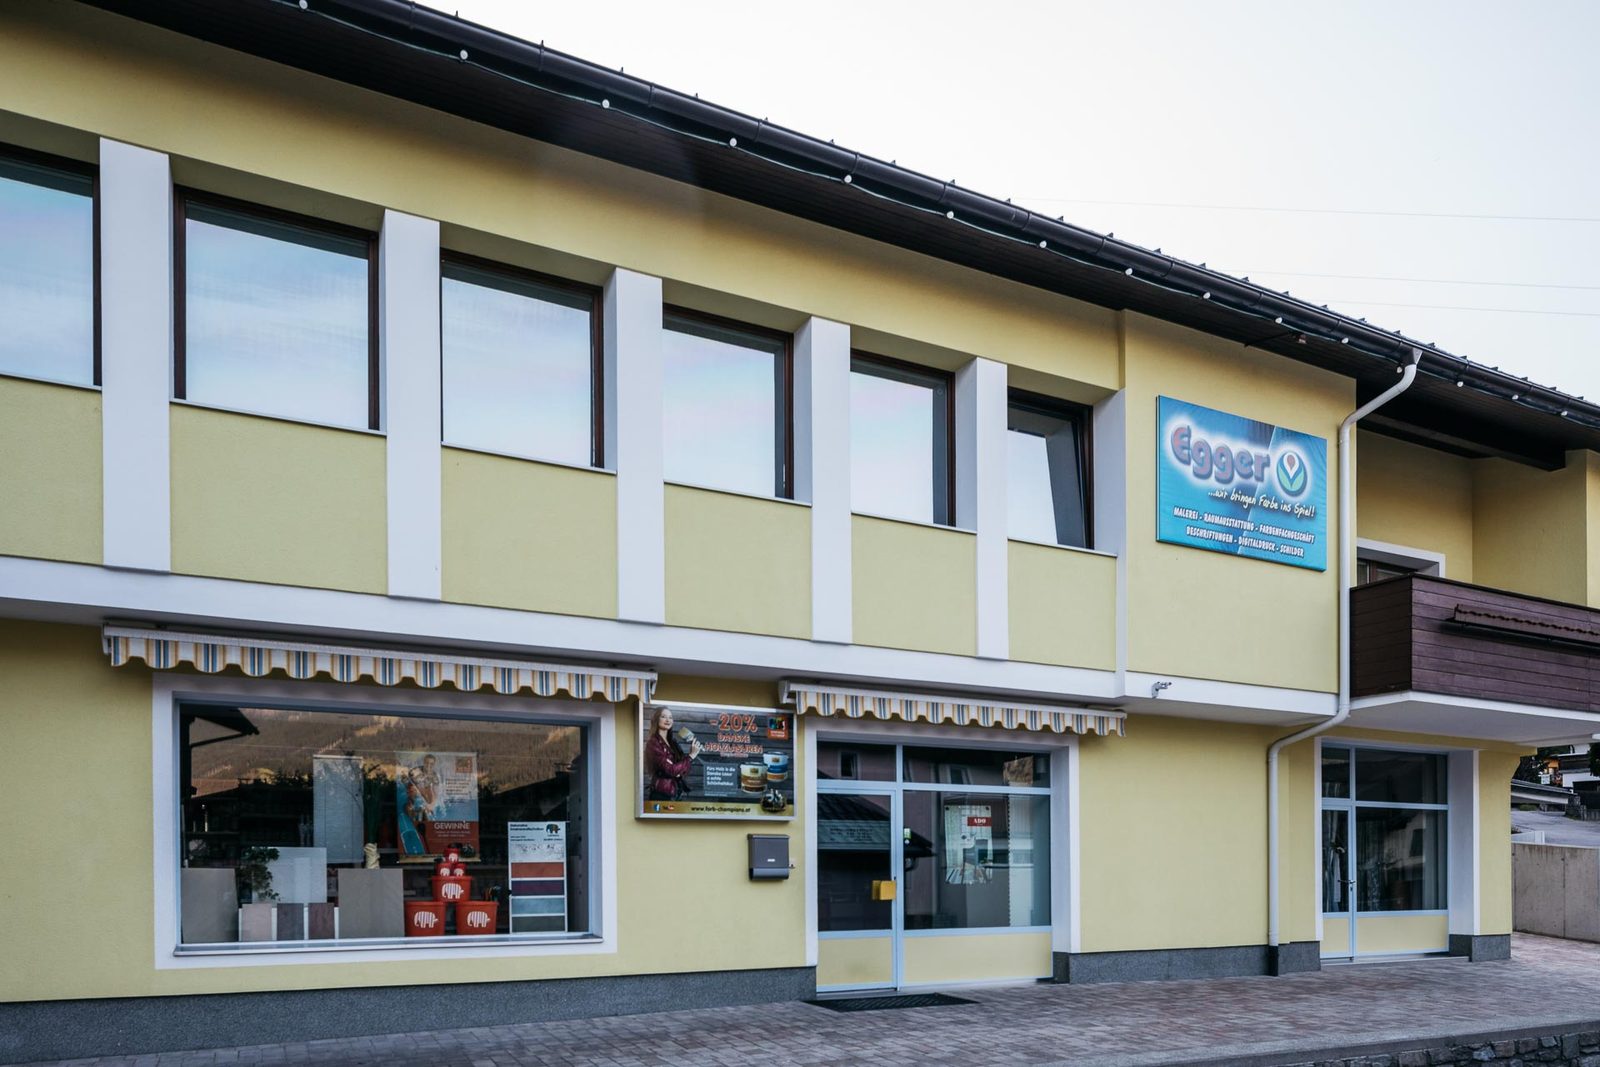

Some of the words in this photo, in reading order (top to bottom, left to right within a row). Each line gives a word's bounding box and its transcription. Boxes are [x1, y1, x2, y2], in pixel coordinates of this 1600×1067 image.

[1171, 425, 1270, 484] Egger
[1230, 488, 1256, 508] bringen
[1258, 494, 1279, 510] Farbe
[1280, 500, 1292, 512] ins
[1294, 503, 1316, 518] Spiel!
[1173, 507, 1198, 520] MALEREI
[1203, 513, 1255, 532] RAUMAUSSTATTUNG
[1259, 524, 1315, 543] FARBENFACHGESCHÄFT
[1186, 526, 1233, 543] BESCHRIFTUNGEN
[1238, 536, 1276, 551] DIGITALDRUCK
[1280, 544, 1304, 557] SCHILDER
[433, 822, 471, 830] GEWINNE
